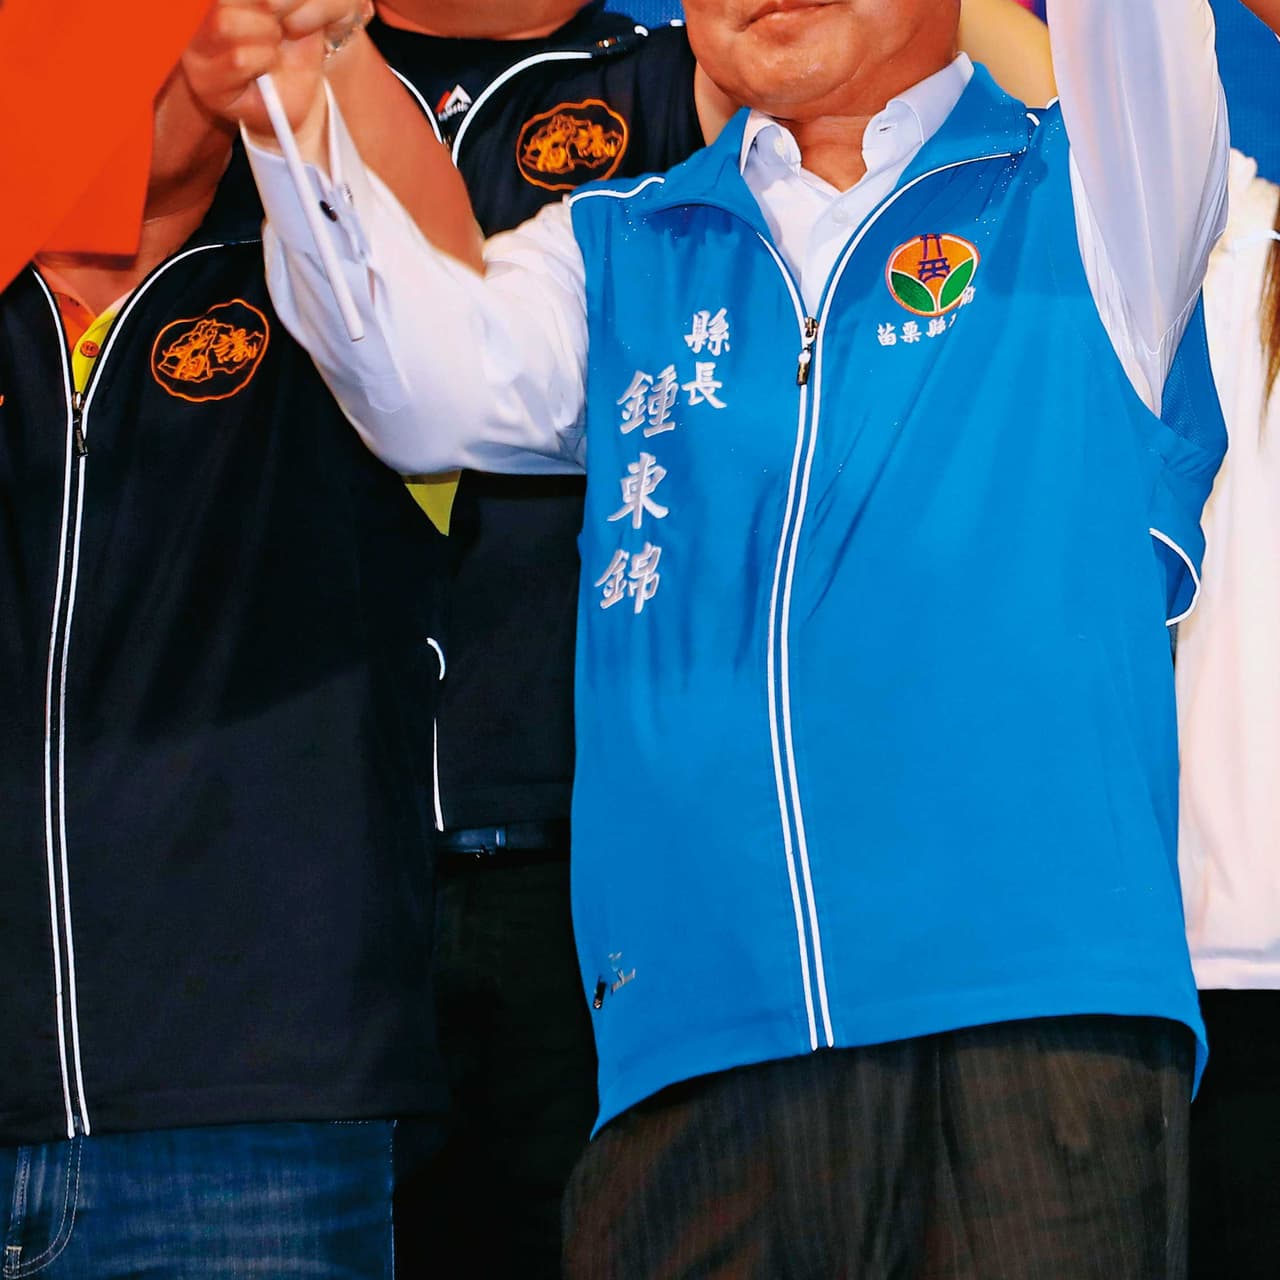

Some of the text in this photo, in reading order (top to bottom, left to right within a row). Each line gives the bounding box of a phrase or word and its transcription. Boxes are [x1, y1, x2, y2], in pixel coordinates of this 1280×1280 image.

[681, 307, 731, 409] 縣長
[876, 286, 977, 347] 苗栗縣府
[594, 363, 681, 614] 鍾東錦
